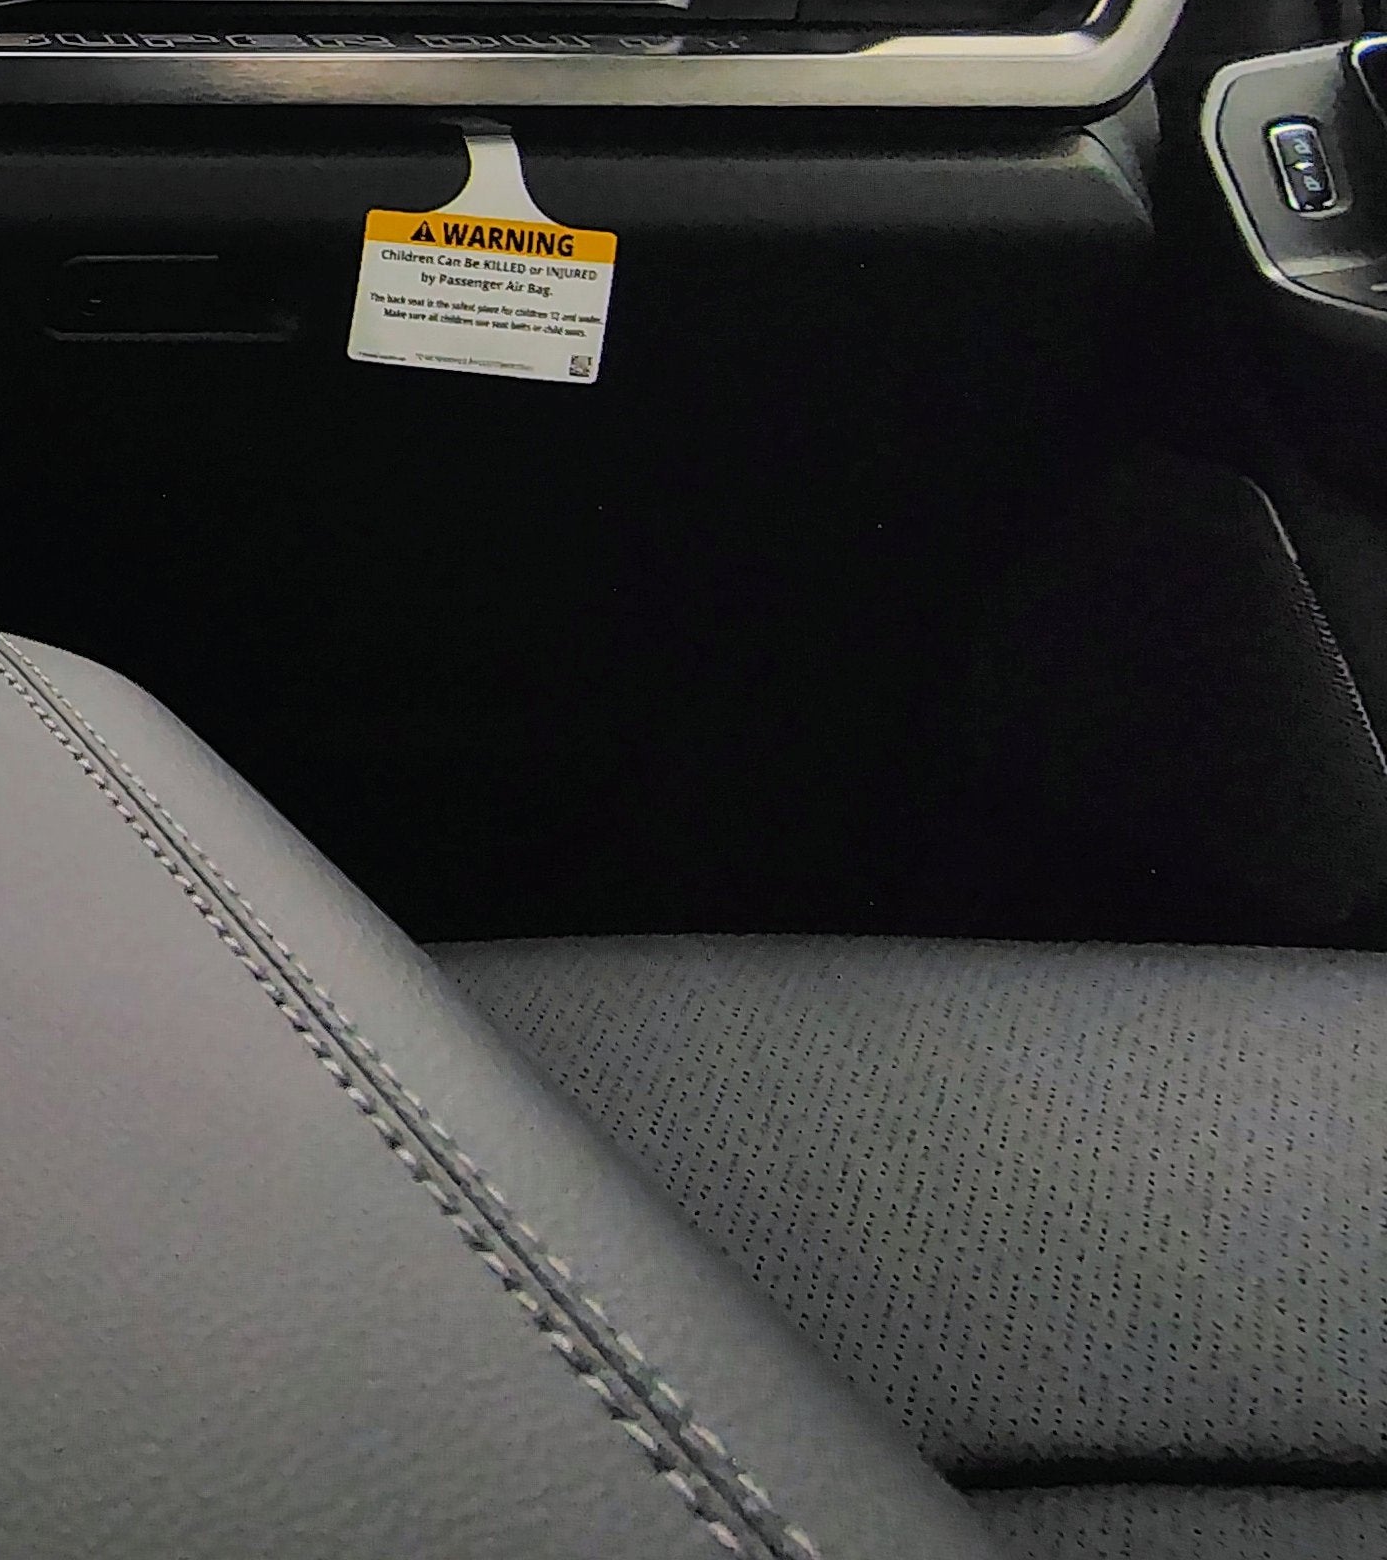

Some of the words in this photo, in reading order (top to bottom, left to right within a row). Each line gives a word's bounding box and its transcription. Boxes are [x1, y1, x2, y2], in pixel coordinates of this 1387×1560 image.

[442, 221, 576, 257] WARNING
[381, 249, 434, 265] Children
[437, 255, 462, 267] Can
[464, 258, 480, 269] Be
[483, 260, 526, 274] KILLED
[529, 267, 544, 275] or
[546, 266, 598, 280] INJURED
[420, 272, 436, 286] by
[439, 274, 504, 292] Passenger
[505, 281, 526, 292] Air
[528, 283, 553, 298] Bag.
